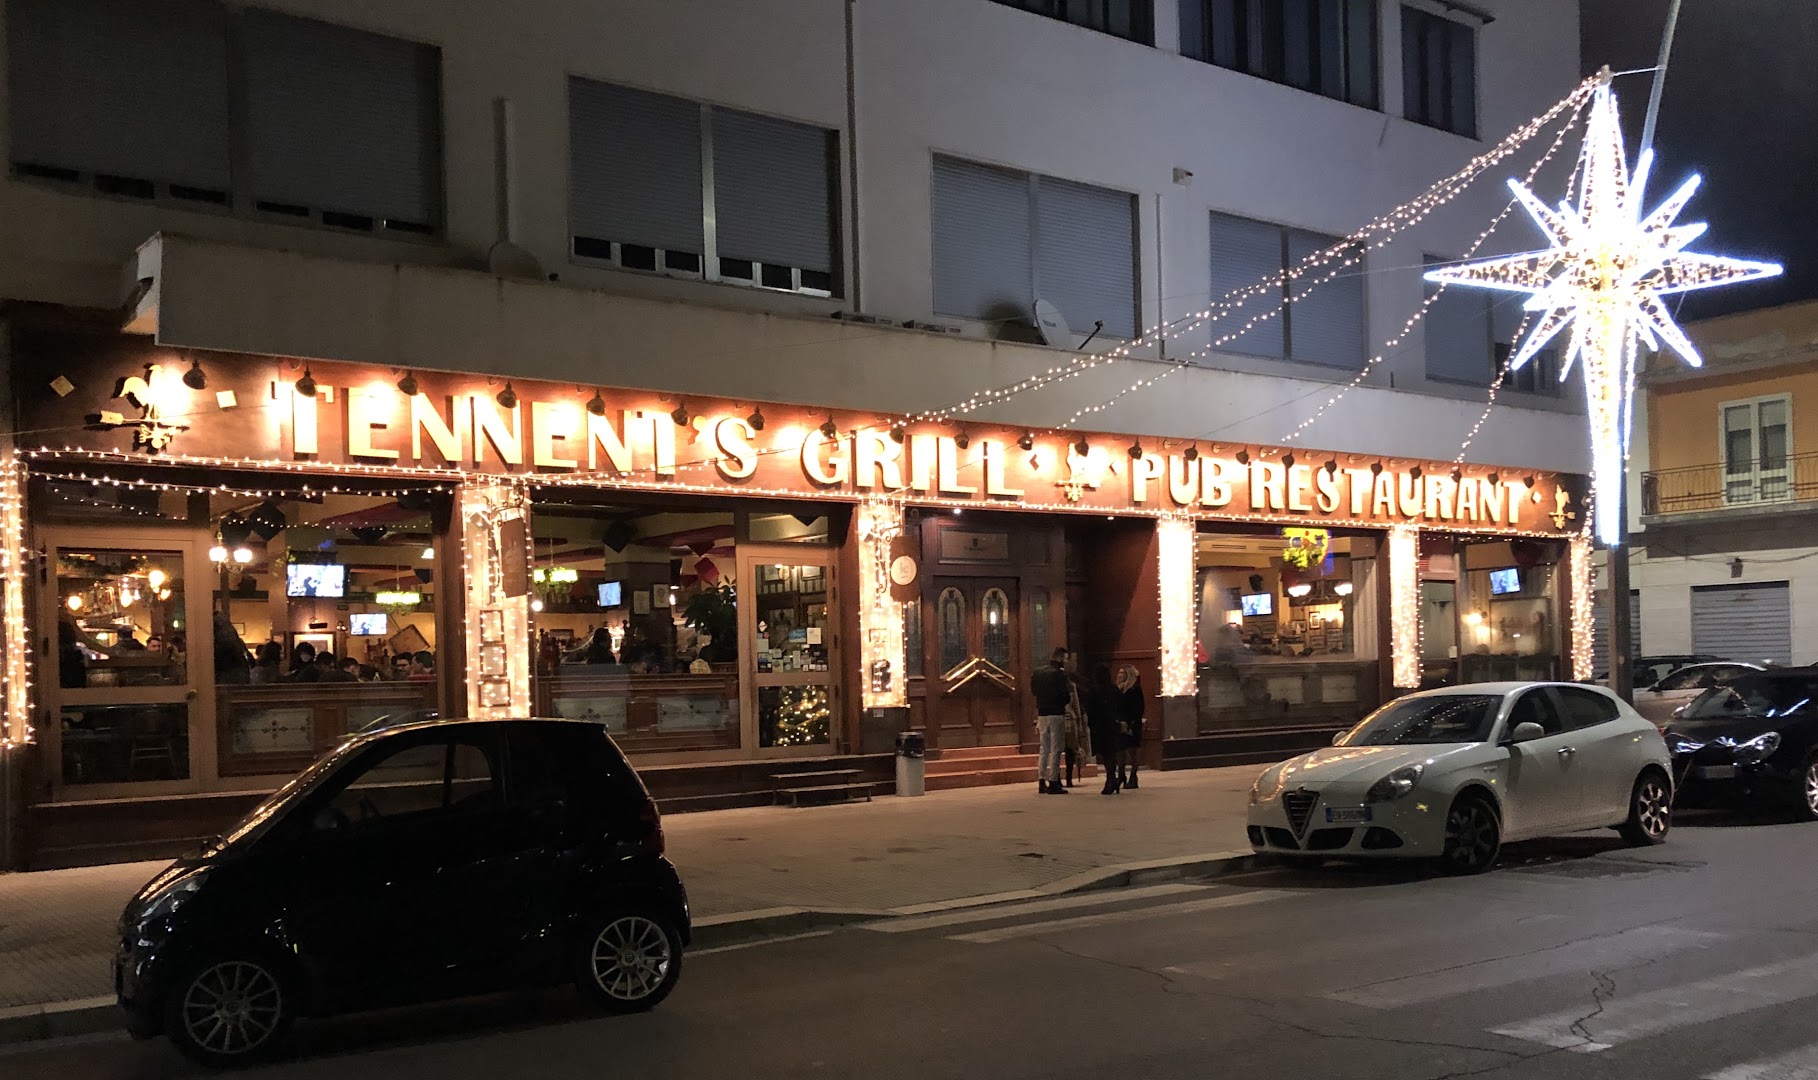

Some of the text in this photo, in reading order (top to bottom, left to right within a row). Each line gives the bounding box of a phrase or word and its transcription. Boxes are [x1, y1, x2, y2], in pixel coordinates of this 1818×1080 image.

[272, 381, 1531, 523] TENNENT'S GRILL PUB RESTAURANT
